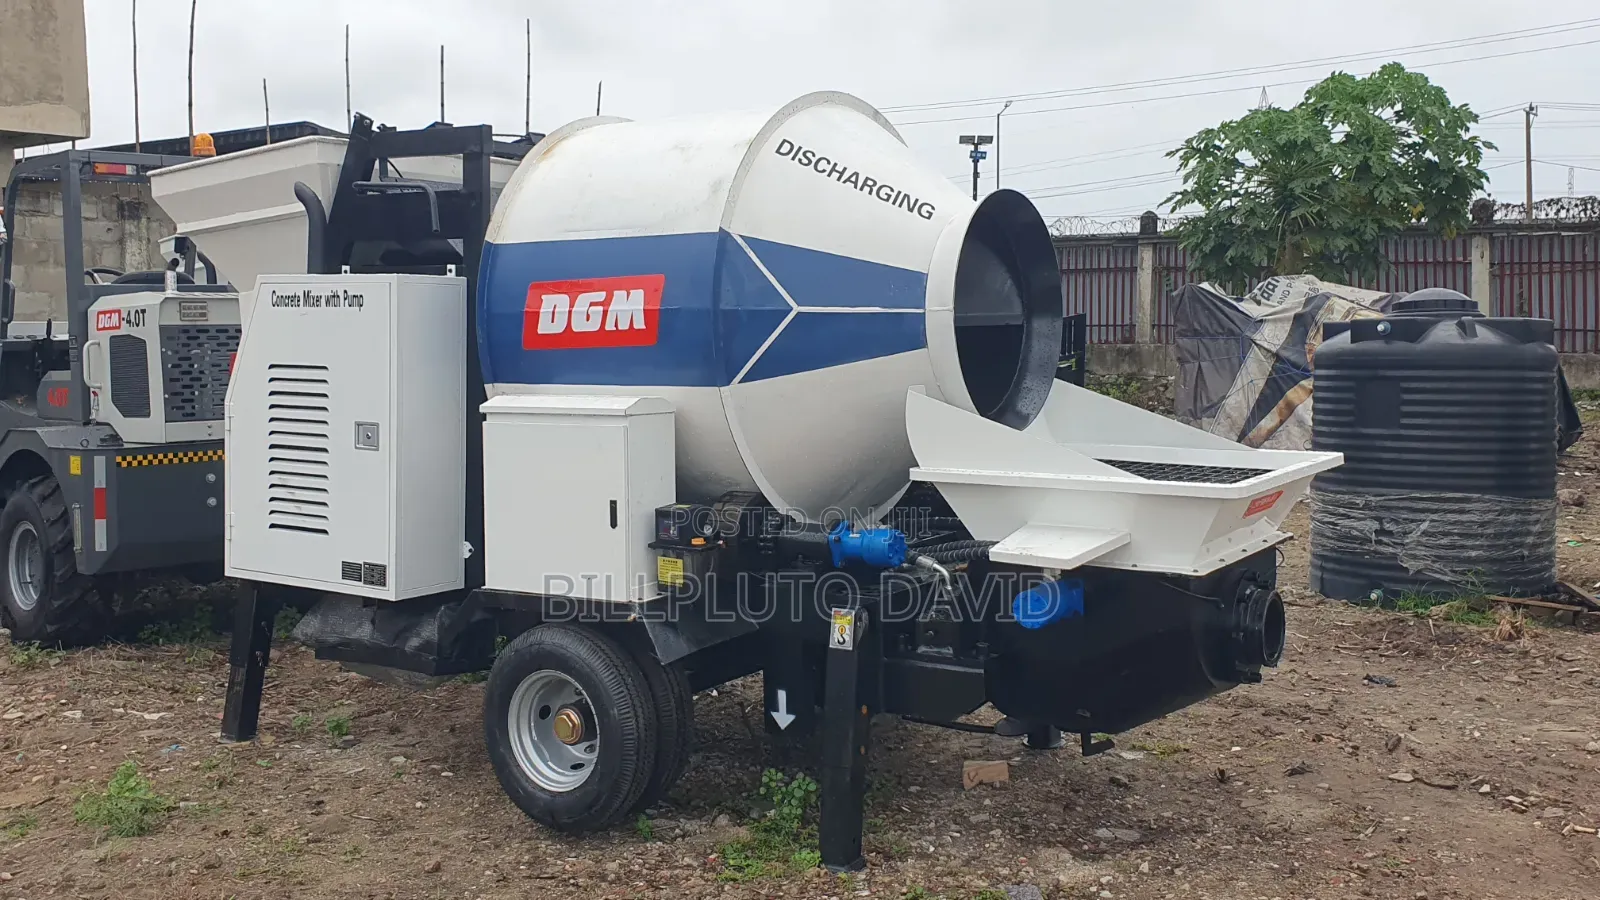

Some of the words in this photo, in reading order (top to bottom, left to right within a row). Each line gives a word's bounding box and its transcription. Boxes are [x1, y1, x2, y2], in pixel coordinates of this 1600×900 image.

[775, 138, 936, 220] DISCHARGING
[271, 290, 300, 308] Concrete
[303, 290, 322, 308] Mixer
[325, 290, 340, 308] with
[344, 289, 364, 312] Pump
[537, 288, 647, 335] DGM
[97, 312, 120, 329] DGM
